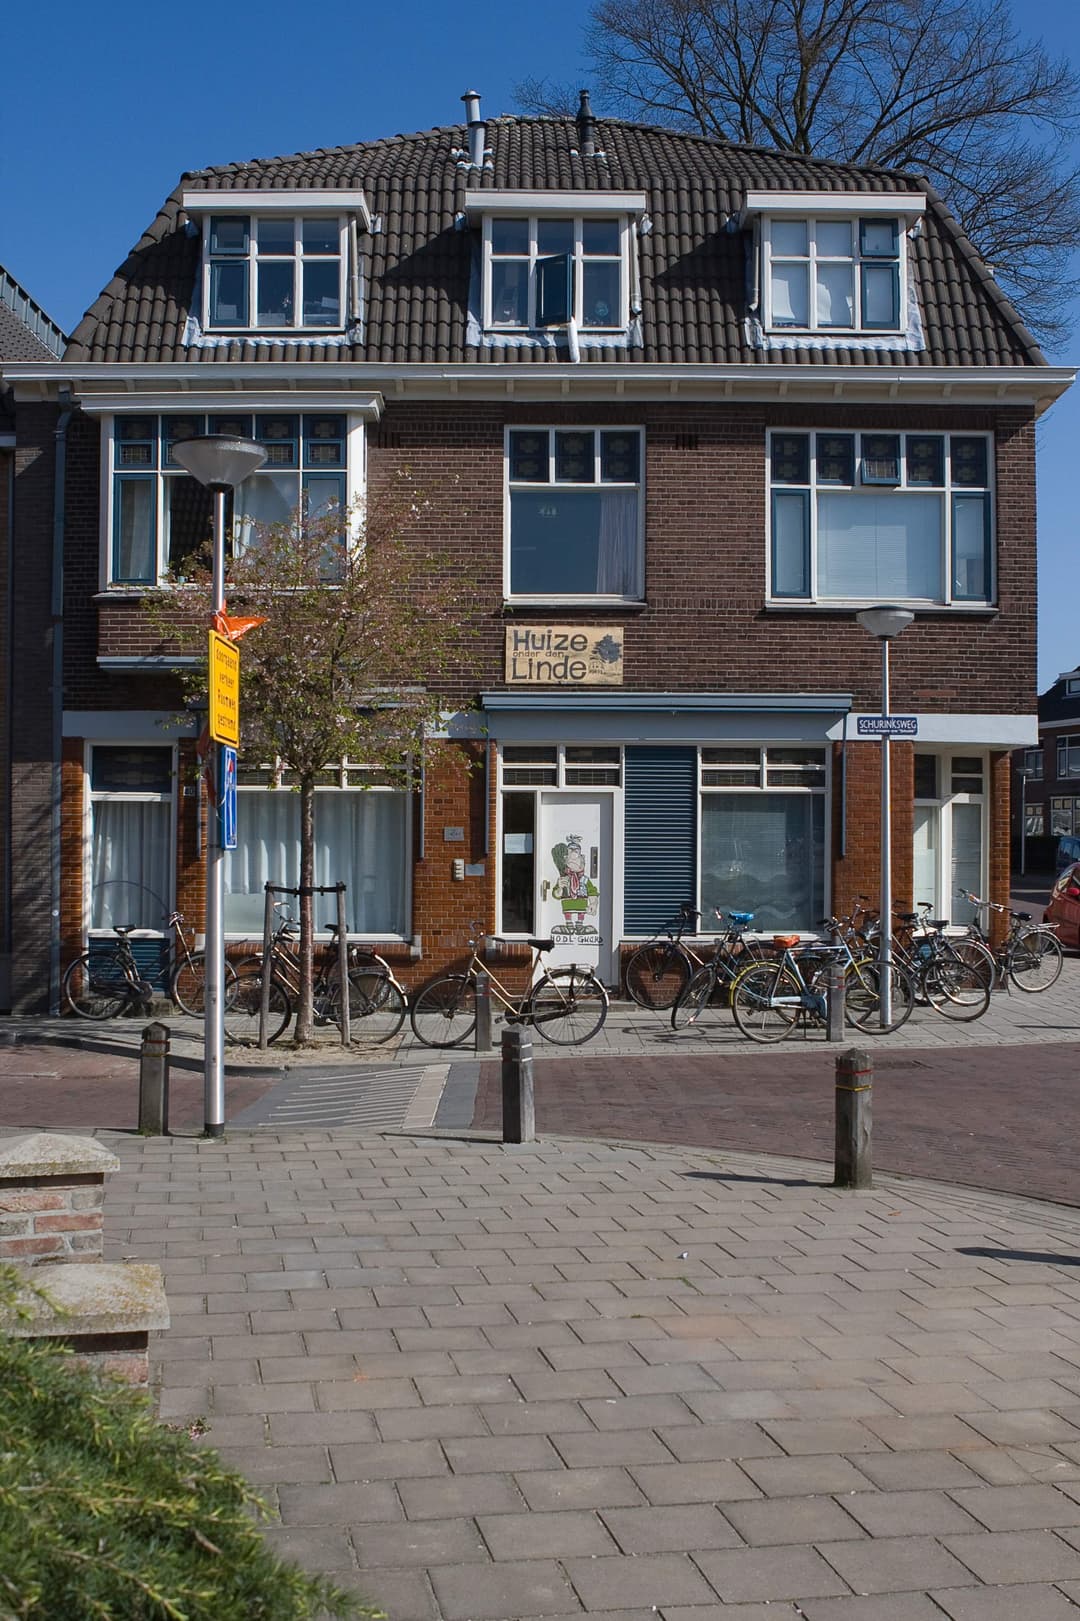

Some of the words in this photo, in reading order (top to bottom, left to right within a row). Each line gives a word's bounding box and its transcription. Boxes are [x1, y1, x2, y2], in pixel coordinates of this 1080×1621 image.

[513, 629, 588, 651] Huize
[512, 650, 540, 658] onder
[545, 650, 565, 658] den
[511, 655, 587, 680] Linde
[859, 719, 917, 729] SCHURINKSWEG
